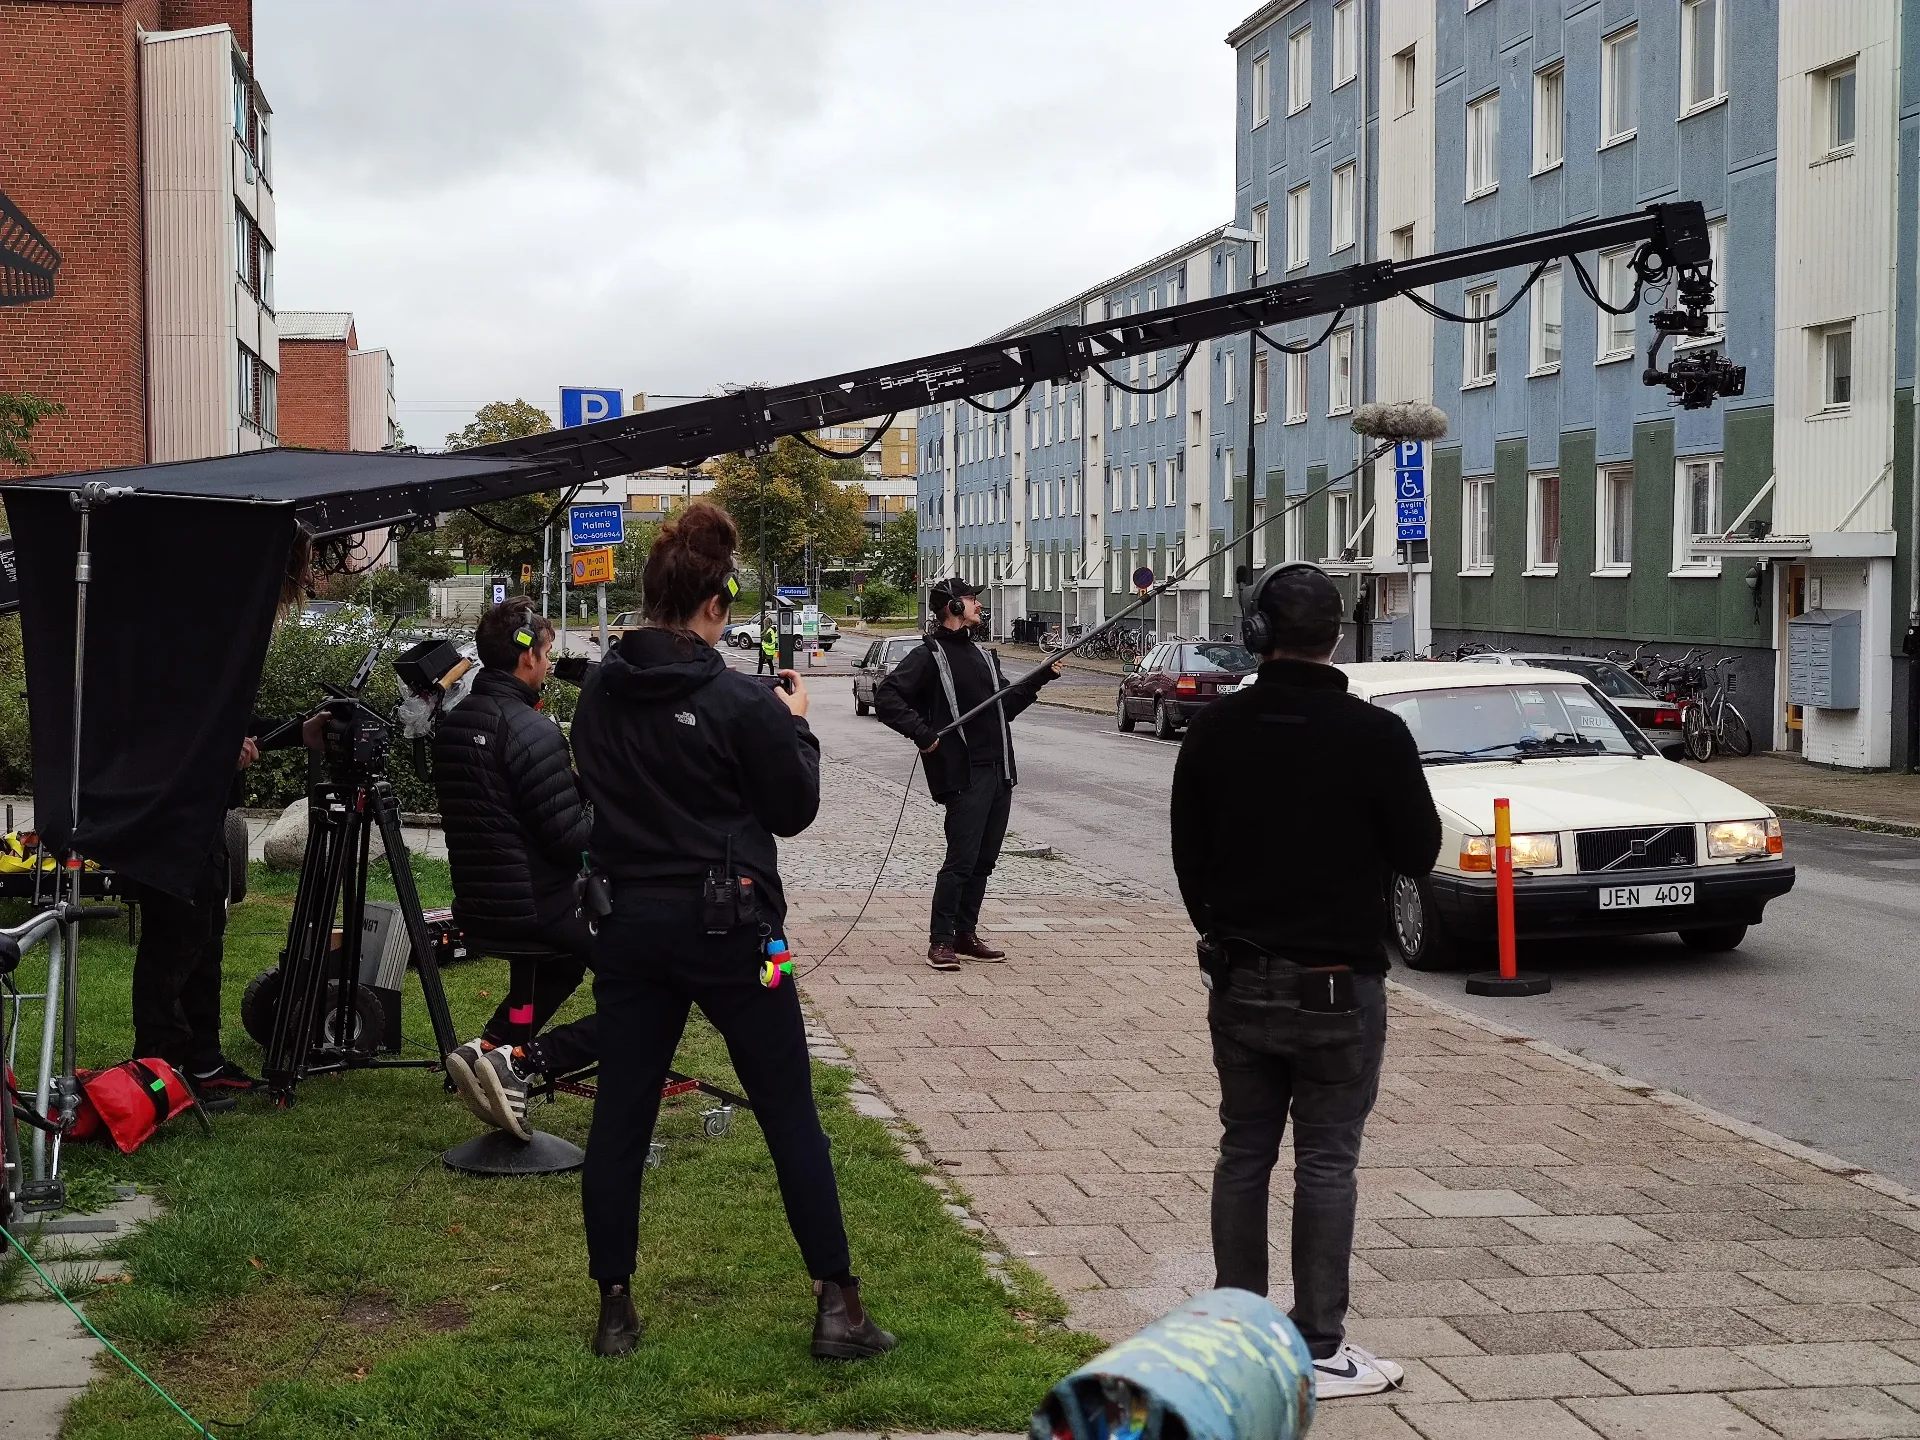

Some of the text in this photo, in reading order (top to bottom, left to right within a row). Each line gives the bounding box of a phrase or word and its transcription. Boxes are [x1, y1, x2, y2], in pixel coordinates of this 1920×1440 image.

[926, 378, 964, 391] Crane
[580, 393, 609, 425] P
[1401, 440, 1418, 466] P
[1400, 501, 1422, 509] Avgift
[573, 510, 618, 519] Parkering
[582, 521, 611, 530] Malmö
[1582, 716, 1602, 727] NRU
[1602, 885, 1692, 907] JEN 409
